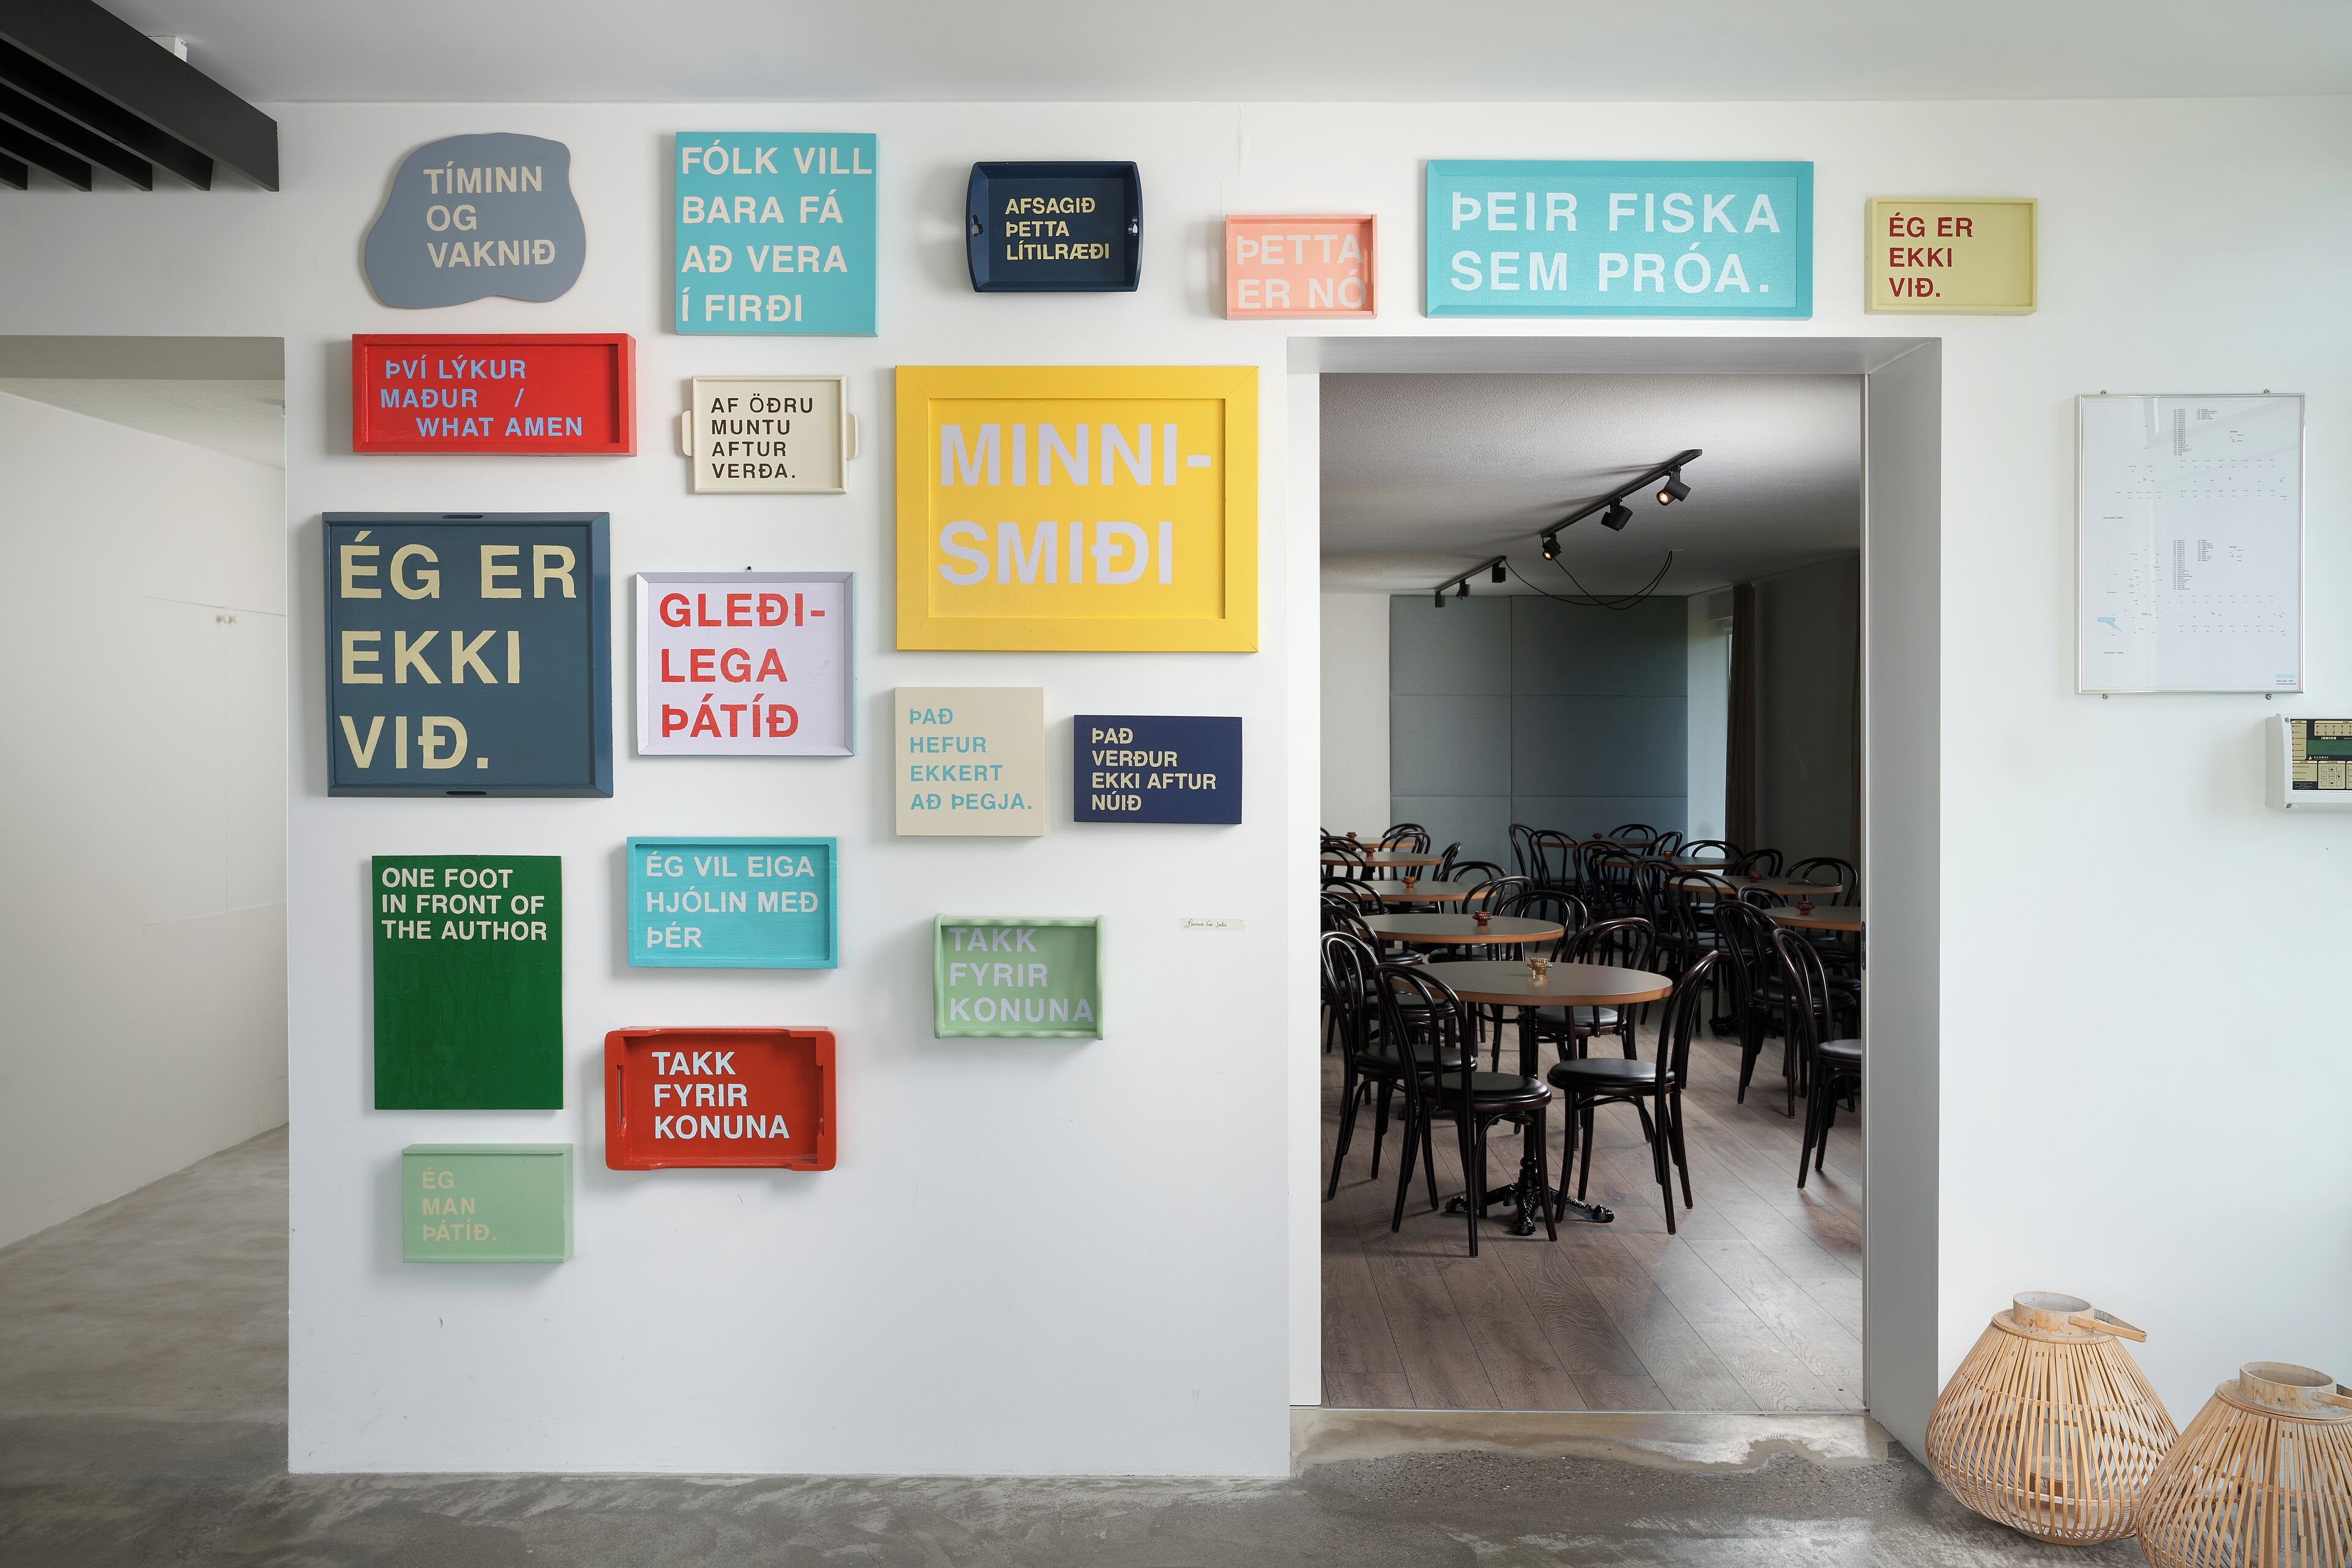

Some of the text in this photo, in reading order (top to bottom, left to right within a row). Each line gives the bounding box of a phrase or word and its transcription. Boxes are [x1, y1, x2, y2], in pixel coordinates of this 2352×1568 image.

[682, 140, 872, 175] FÓLK VILL
[424, 161, 541, 194] TÍMINN
[684, 189, 843, 223] BARA FÁ
[1005, 197, 1095, 214] AFSAGIÐ
[1452, 192, 1780, 233] ÞEIR FISKA
[427, 205, 477, 231] OG
[1006, 221, 1069, 237] ÞETTA
[1890, 213, 1972, 238] ÉG ER
[427, 239, 555, 268] VAKNIÐ
[682, 245, 847, 273] AÐ VERA
[1007, 240, 1109, 260] LÍTILRÆÐI
[1237, 235, 1362, 265] ÞETTA
[1890, 247, 1951, 267] EKKI
[1451, 242, 1768, 293] SEM PRÓA.
[1238, 270, 1366, 309] ER NÓ
[1889, 278, 1940, 297] VIÐ.
[682, 287, 801, 322] Í FIRÐI
[386, 355, 525, 379] ÞVÍ LÝKUR
[380, 388, 522, 408] MAÐUR /
[711, 393, 812, 413] AF ÖÐRU
[416, 417, 582, 437] WHAT AMEN
[712, 420, 790, 435] MUNTU
[712, 442, 785, 456] AFTUR
[941, 424, 1210, 486] MINNI-
[712, 464, 795, 478] VERÐA.
[341, 531, 576, 600] ÉG ER
[939, 521, 1172, 586] SMIÐI
[660, 593, 824, 627] GLEÐI-
[342, 630, 519, 684] EKKI
[662, 648, 786, 682] LEGA
[662, 693, 797, 737] ÞÁTÍÐ
[910, 708, 953, 725] ÞAÐ
[340, 715, 488, 769] VIÐ.
[910, 737, 986, 753] HEFUR
[1092, 728, 1133, 744] ÞAÐ
[1092, 750, 1177, 767] VERÐUR
[911, 764, 1003, 781] EKKERT
[1092, 772, 1216, 790] EKKI AFTUR
[911, 793, 1031, 810] AÐ ÞEGJA.
[1092, 791, 1141, 810] NÚIÐ
[647, 851, 813, 877] ÉG VIL EIGA
[382, 867, 513, 888] ONE FOOT
[383, 895, 545, 914] IN FRONT OF
[647, 886, 818, 913] HJÓLIN MEÐ
[382, 920, 546, 940] THE AUTHOR
[647, 921, 701, 948] ÞÉR
[949, 928, 1036, 952] TAKK
[951, 963, 1047, 987] FYRIR
[951, 997, 1093, 1022] KONUNA
[652, 1051, 736, 1075] TAKK
[654, 1084, 747, 1107] FYRIR
[655, 1115, 790, 1139] KONUNA
[423, 1167, 454, 1189] ÉG
[423, 1198, 475, 1215] MAN
[423, 1219, 497, 1242] ÞÁTÍÐ.
